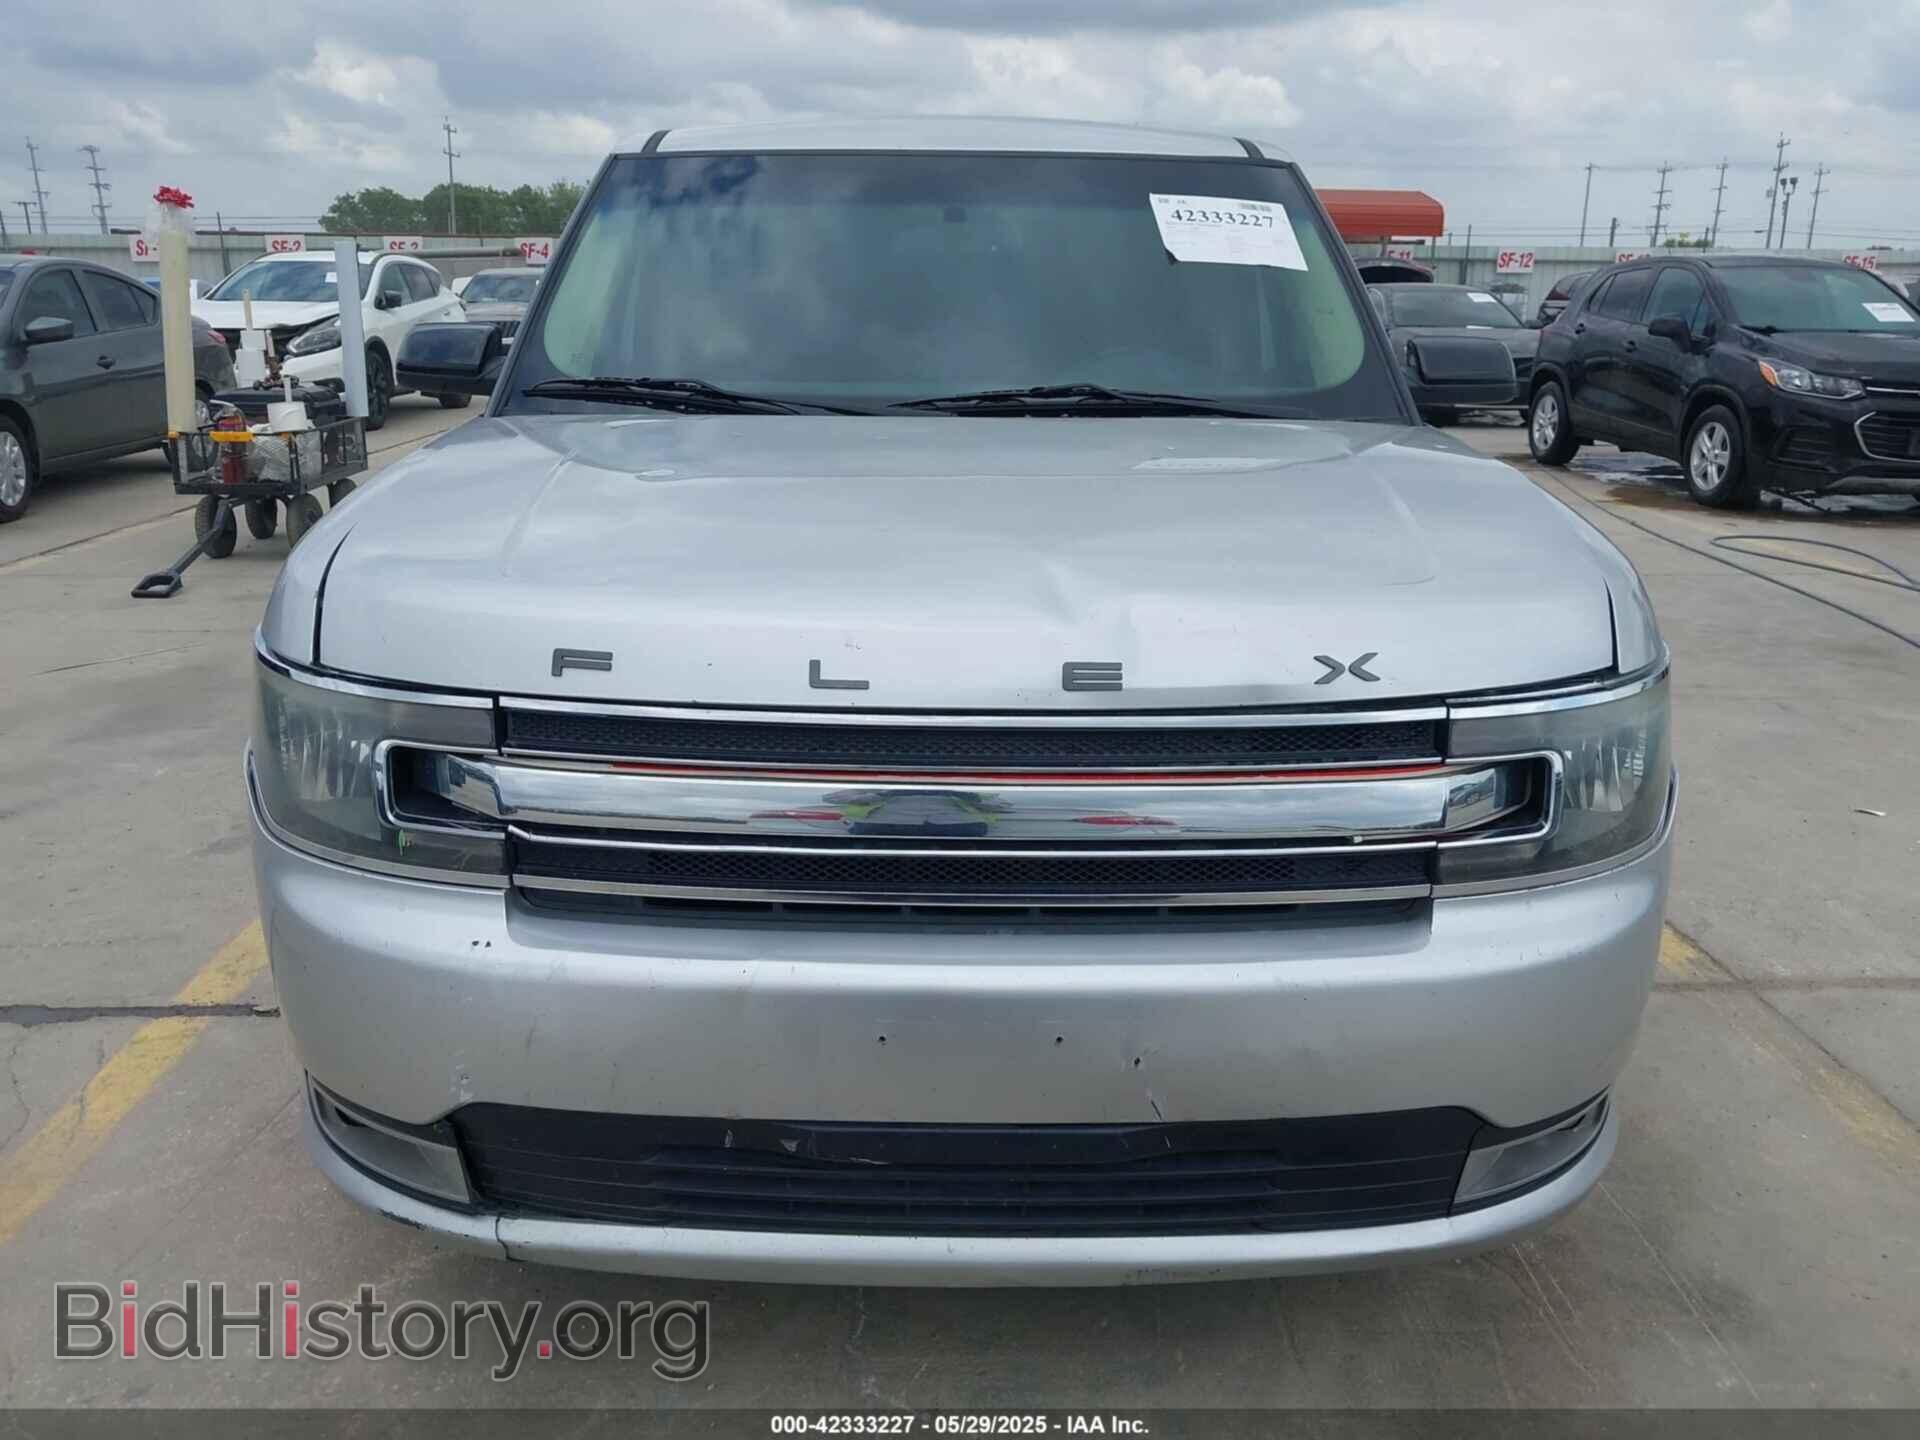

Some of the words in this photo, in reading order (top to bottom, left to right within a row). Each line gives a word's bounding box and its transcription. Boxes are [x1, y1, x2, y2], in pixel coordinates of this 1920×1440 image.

[1171, 209, 1273, 228] 42333227
[520, 242, 549, 258] SF-4
[1499, 252, 1534, 268] SF-12
[551, 648, 1381, 692] FLEX
